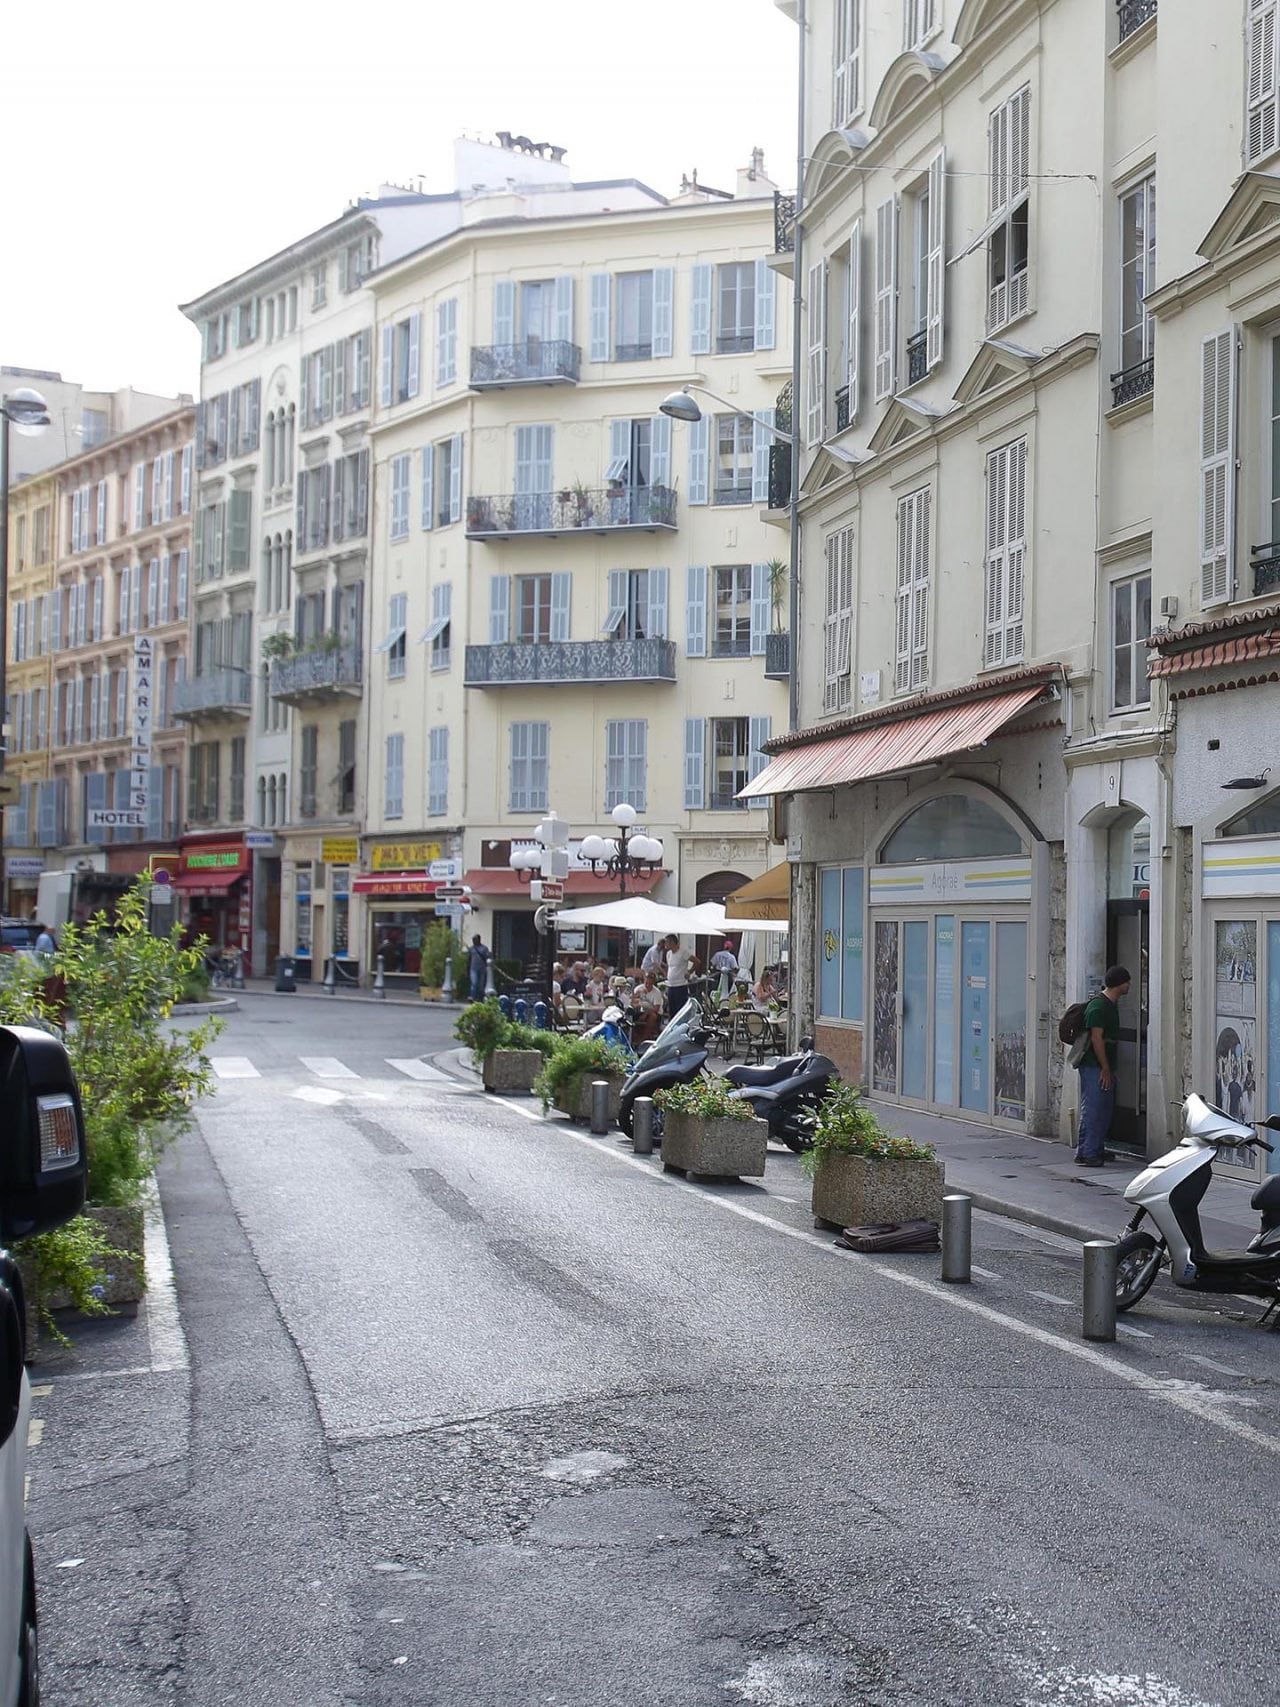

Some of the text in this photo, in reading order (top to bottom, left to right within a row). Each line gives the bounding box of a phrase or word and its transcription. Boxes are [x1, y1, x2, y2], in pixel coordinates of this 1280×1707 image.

[135, 637, 151, 805] AMARYLLIS
[1109, 775, 1115, 791] 9
[94, 812, 145, 825] HOTEL
